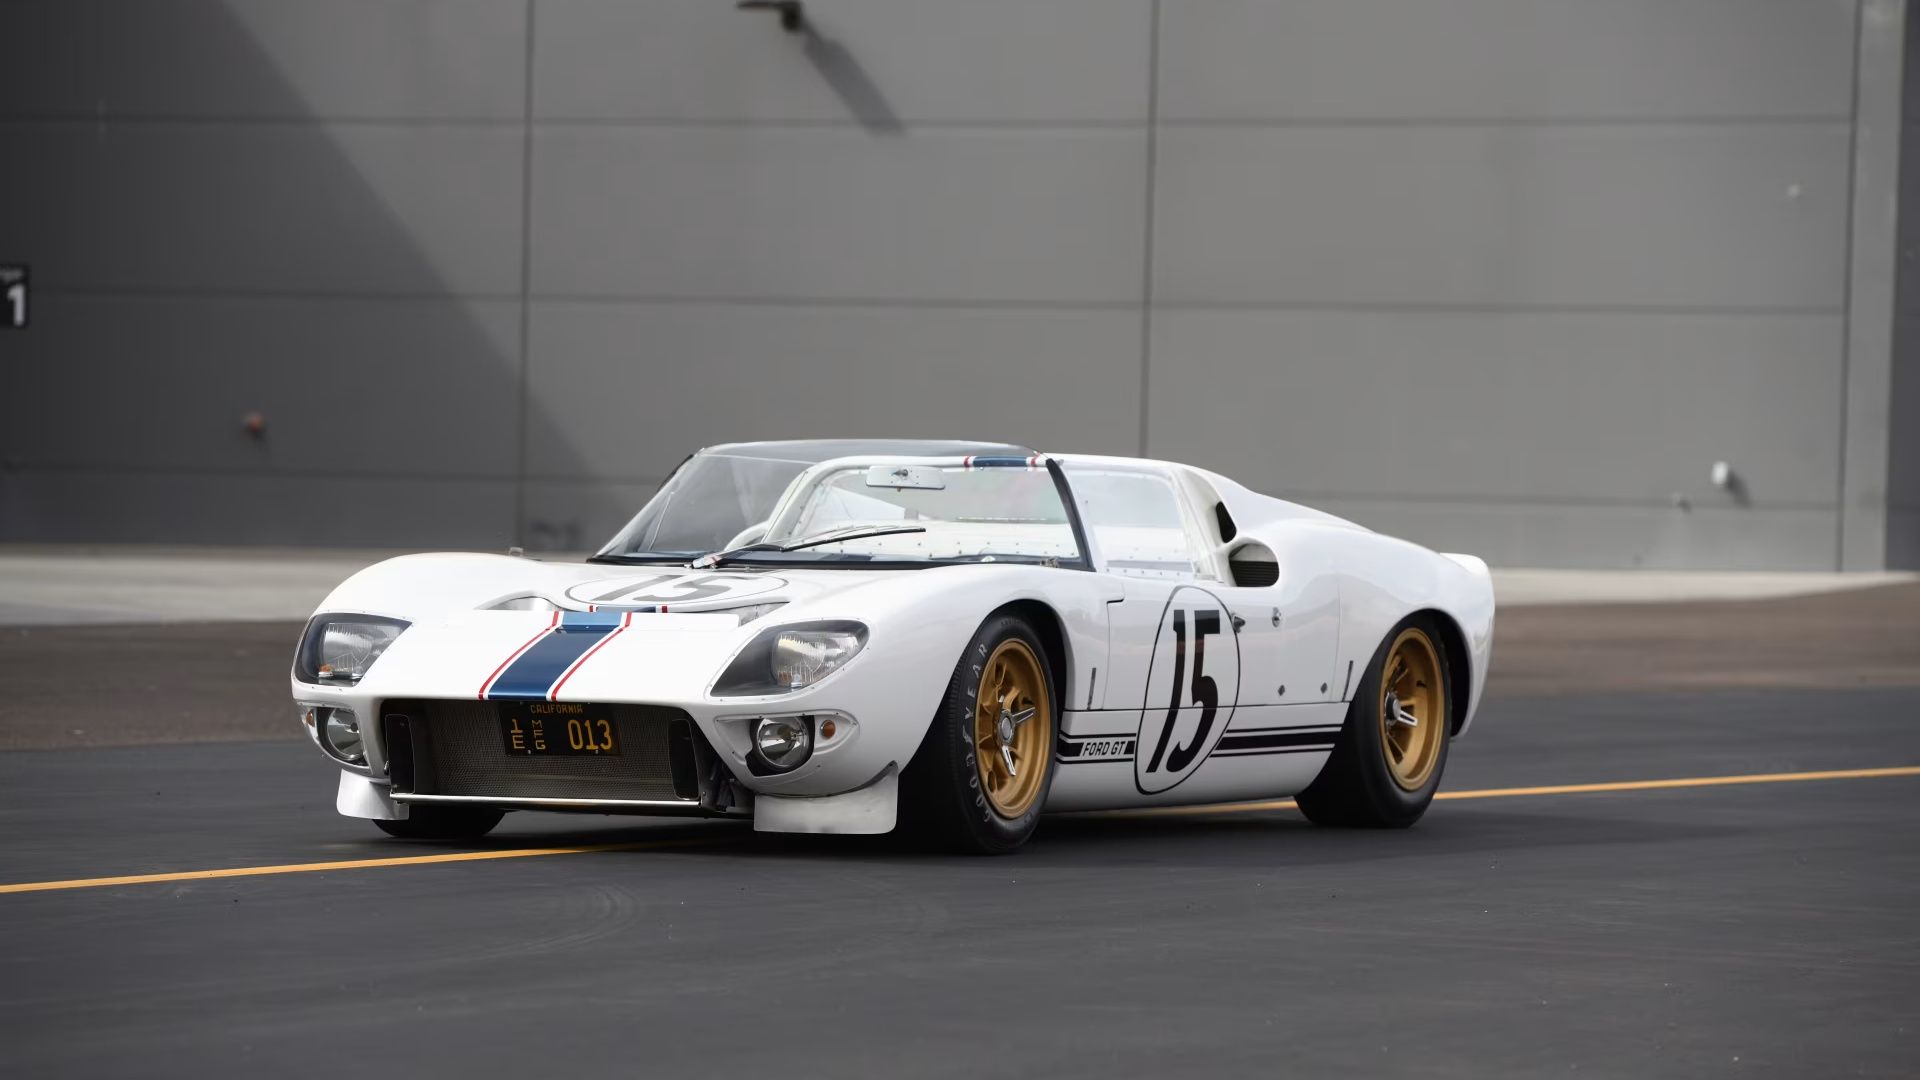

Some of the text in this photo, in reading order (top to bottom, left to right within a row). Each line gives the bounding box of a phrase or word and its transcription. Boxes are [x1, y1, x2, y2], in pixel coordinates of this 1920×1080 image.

[591, 575, 765, 601] 15
[1145, 609, 1220, 773] 15
[530, 704, 583, 714] CALIFORNIA
[567, 719, 612, 750] 013
[1082, 741, 1125, 756] FORD GT
